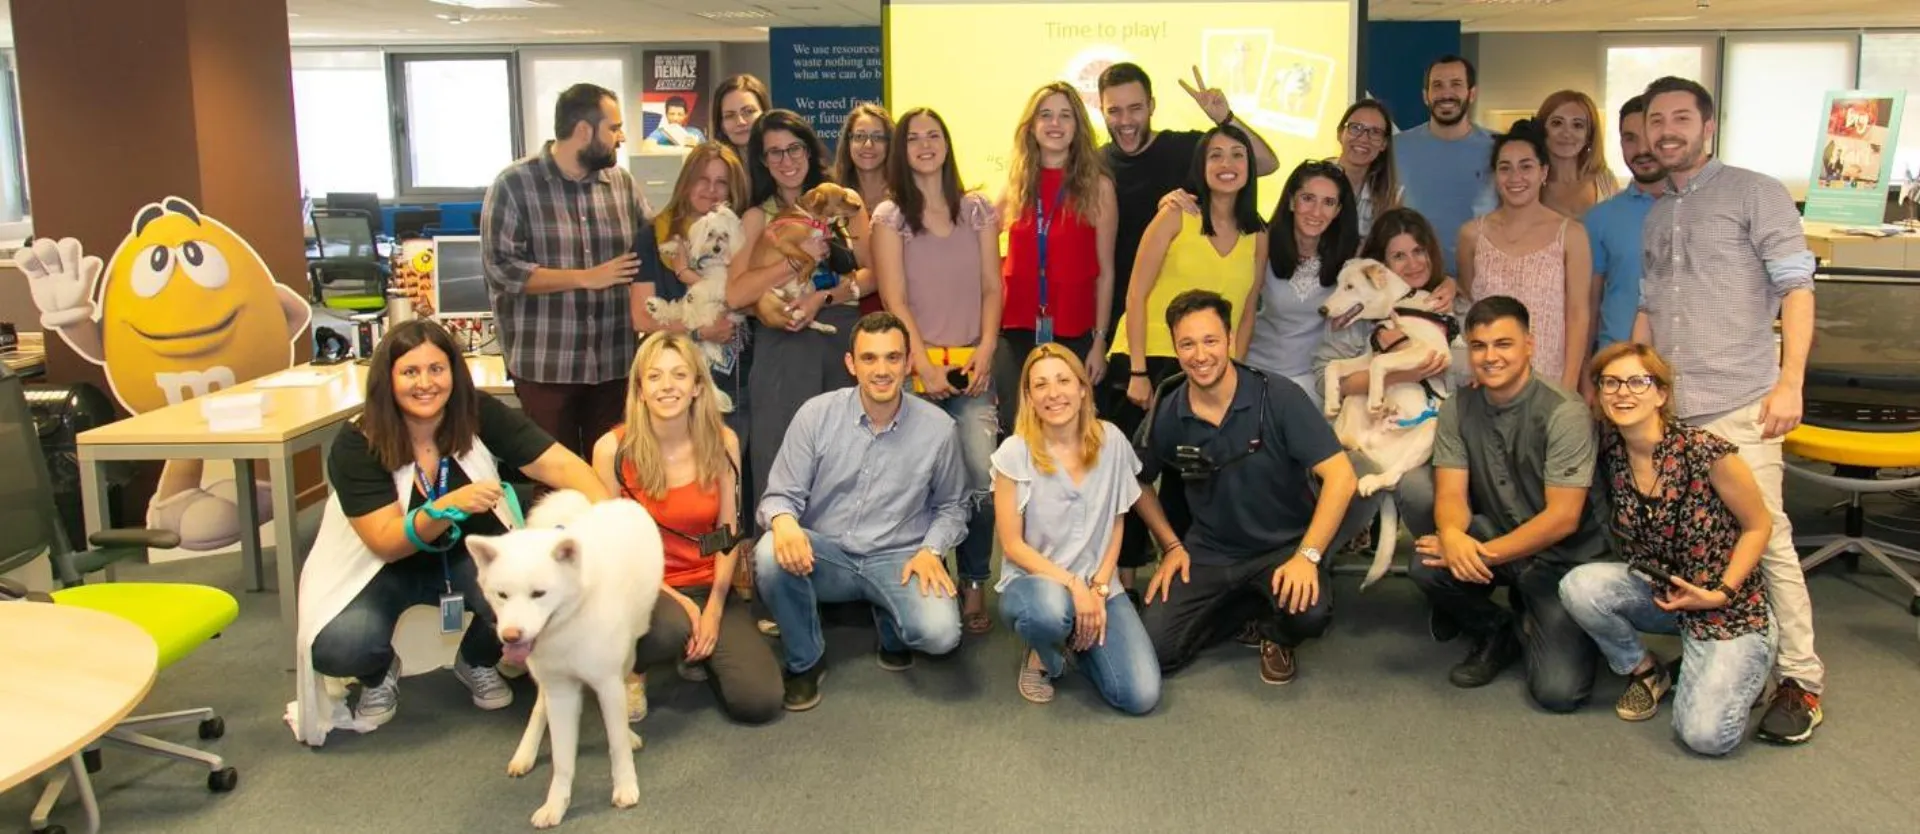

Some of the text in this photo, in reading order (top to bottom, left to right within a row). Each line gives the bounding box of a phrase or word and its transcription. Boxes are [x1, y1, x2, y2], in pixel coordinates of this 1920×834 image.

[1044, 20, 1167, 43] Time to play!
[793, 43, 880, 54] We use resources
[793, 58, 822, 67] waste
[825, 56, 864, 68] nothing
[794, 69, 819, 79] what
[821, 70, 836, 79] we
[839, 70, 857, 79] can
[859, 68, 873, 79] do
[795, 97, 815, 109] We
[818, 97, 846, 109] need
